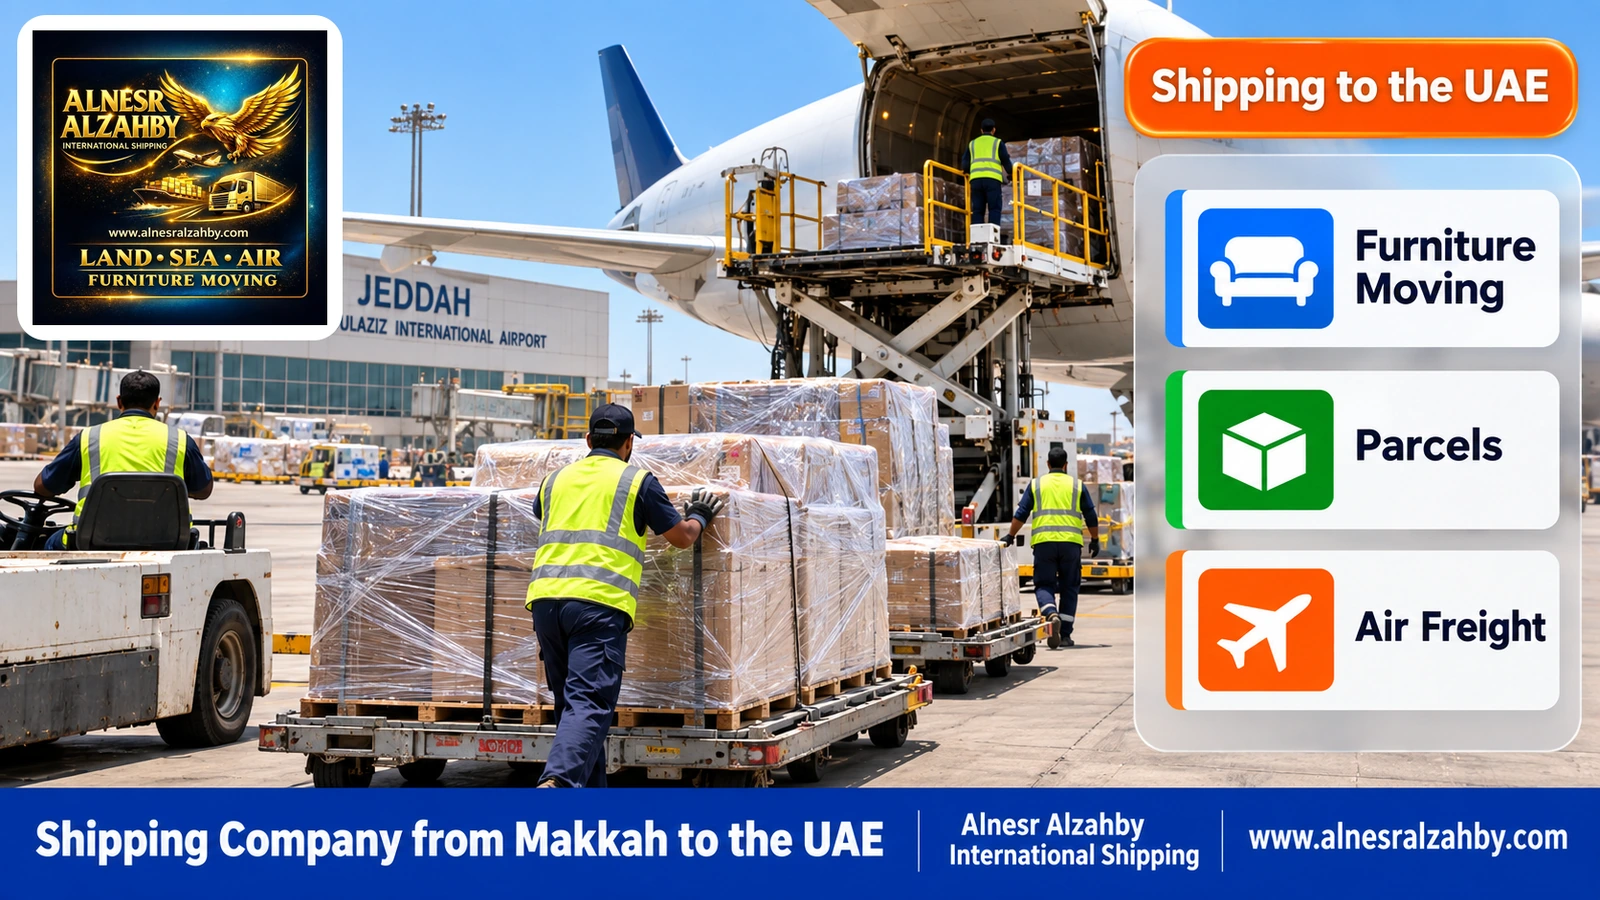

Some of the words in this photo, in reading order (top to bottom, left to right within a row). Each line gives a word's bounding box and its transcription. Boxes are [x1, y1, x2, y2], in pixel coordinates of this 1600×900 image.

[357, 274, 471, 317] JEDDAH
[395, 320, 494, 344] INTERNATIONAL
[499, 330, 547, 349] AIRPORT
